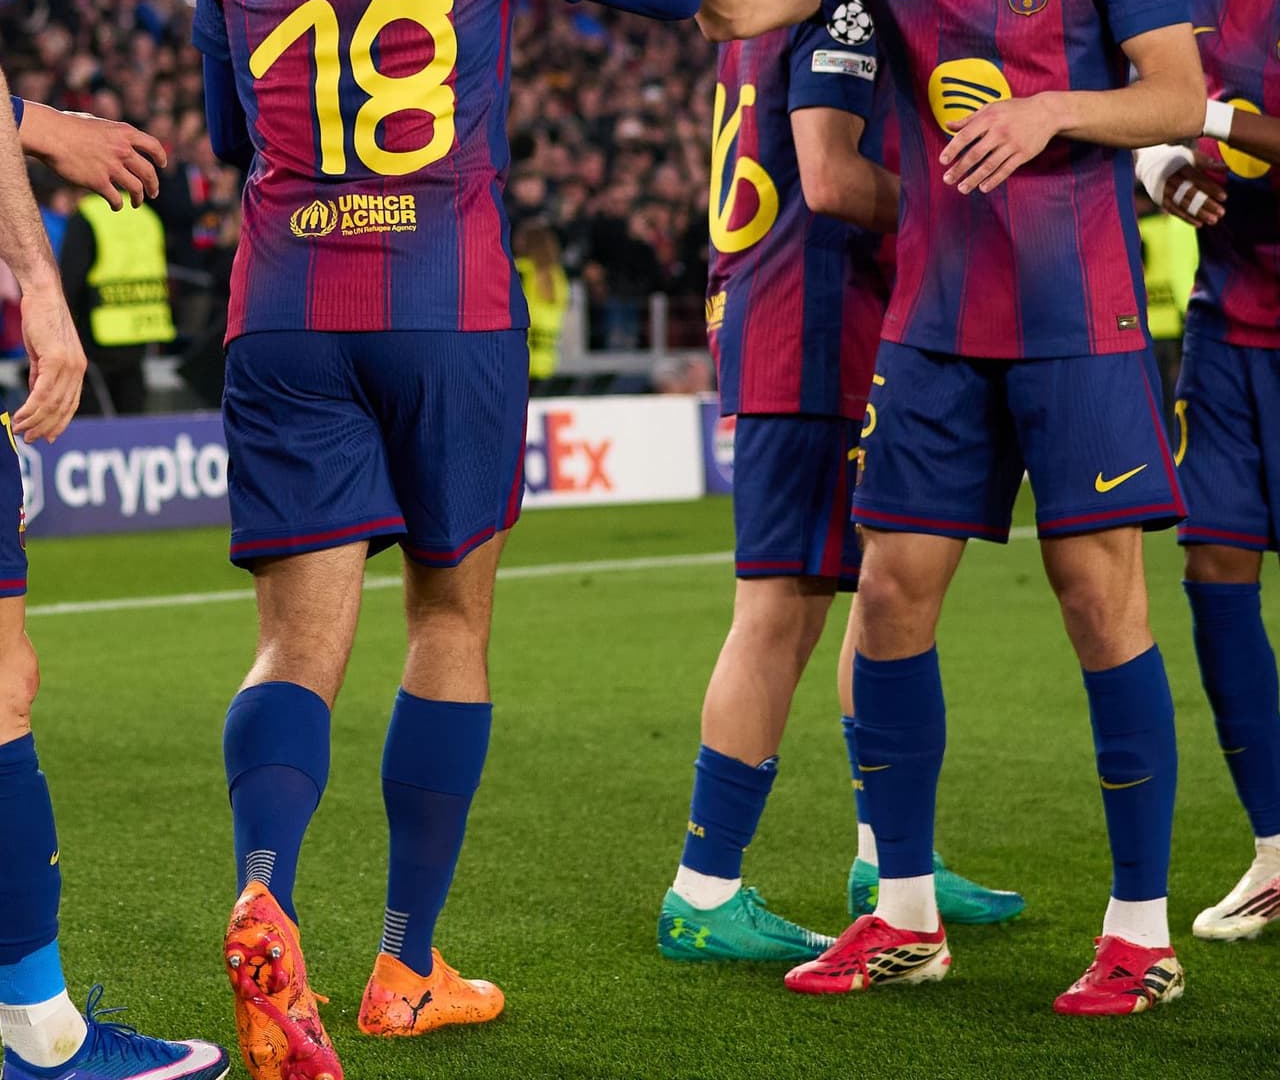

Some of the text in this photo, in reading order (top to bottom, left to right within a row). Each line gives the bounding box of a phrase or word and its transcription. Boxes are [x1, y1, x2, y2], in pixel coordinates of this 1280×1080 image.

[338, 194, 416, 212] UNHCR
[340, 209, 417, 230] ACNUR
[55, 434, 228, 517] crypto
[524, 410, 613, 495] dEx
